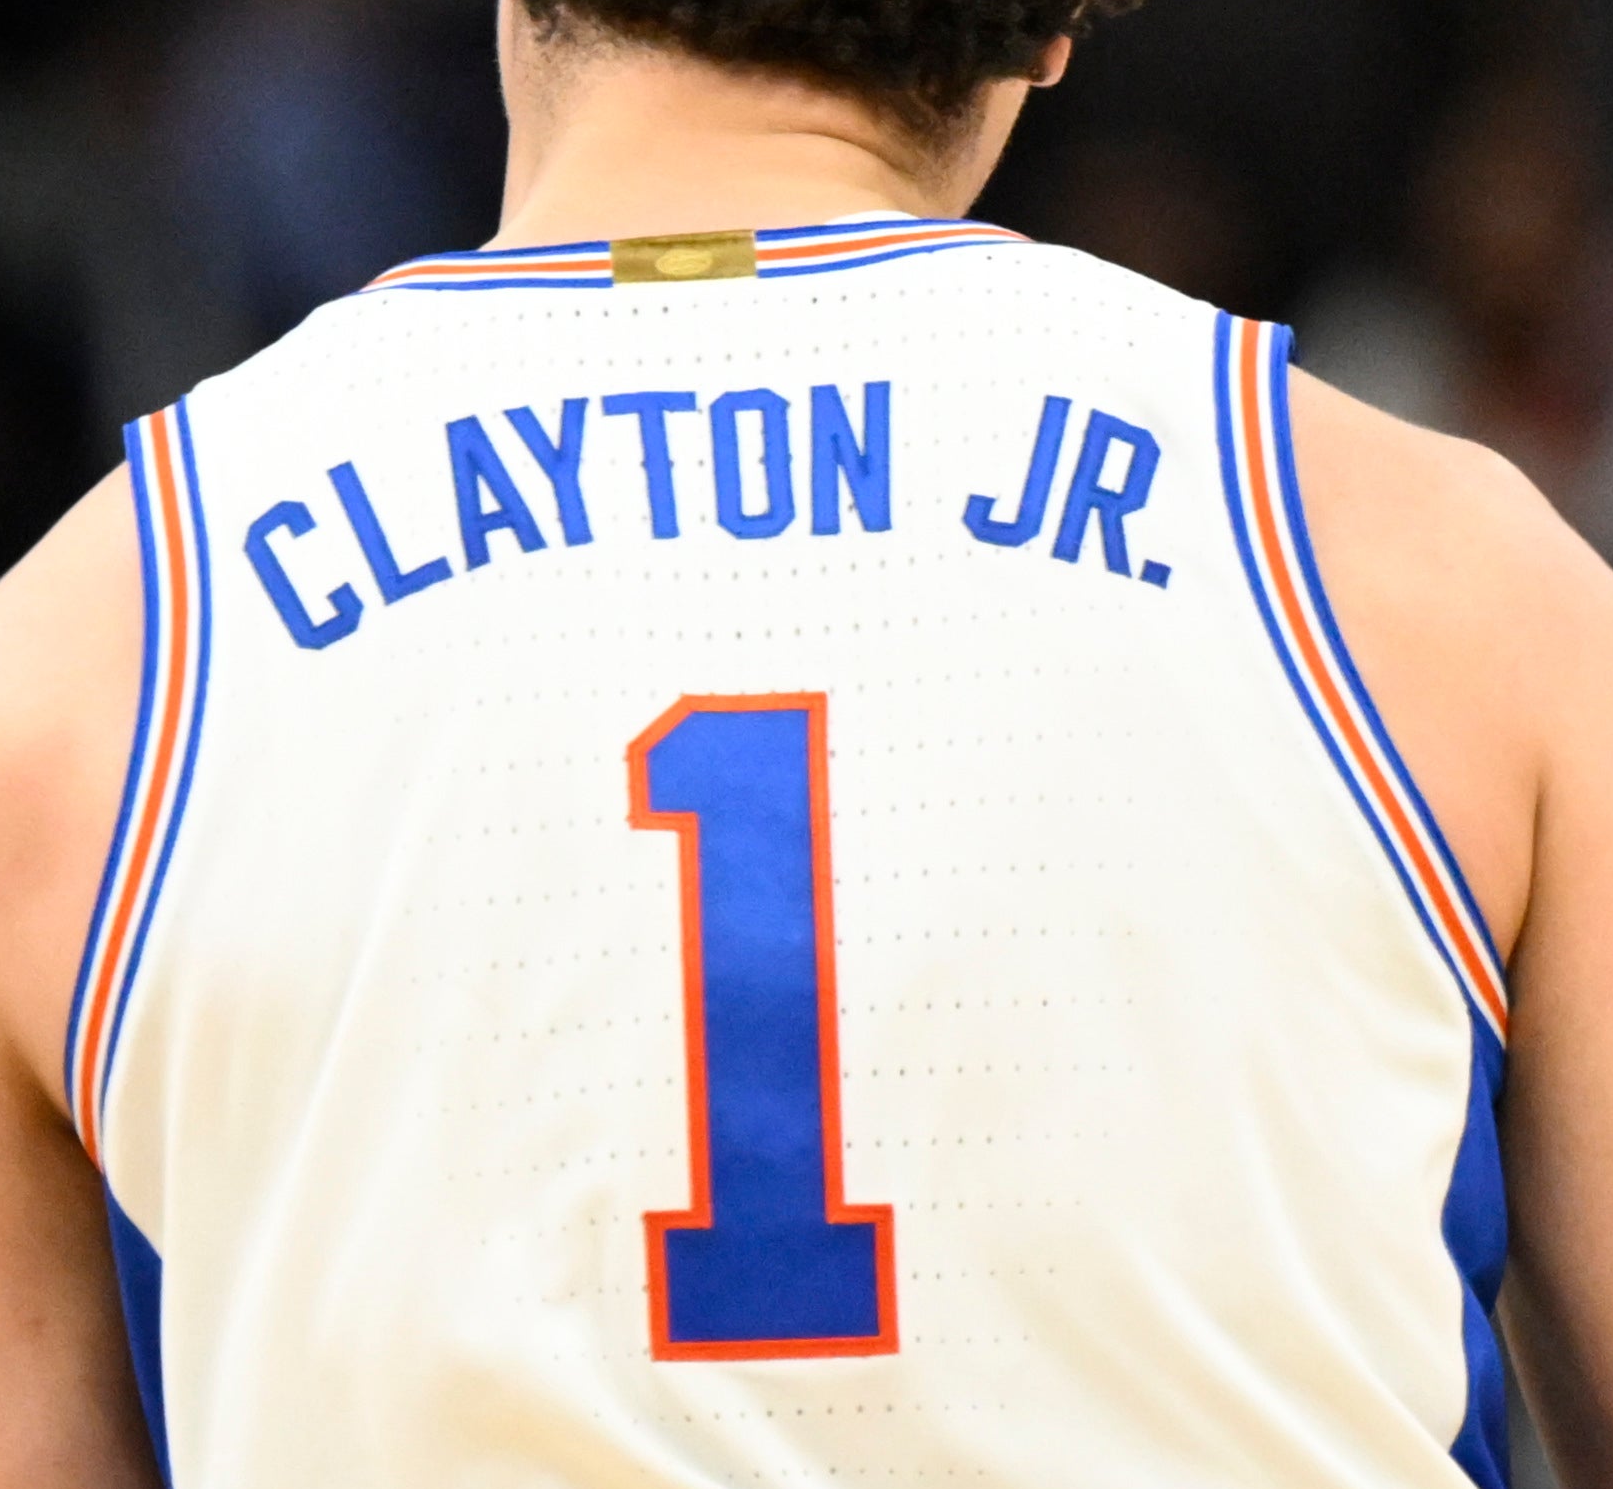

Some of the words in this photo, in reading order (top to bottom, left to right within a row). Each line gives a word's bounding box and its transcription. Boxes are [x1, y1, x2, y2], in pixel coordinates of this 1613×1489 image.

[244, 379, 893, 650] CLAYTON
[962, 394, 1173, 589] JR.
[625, 690, 899, 1362] 1
